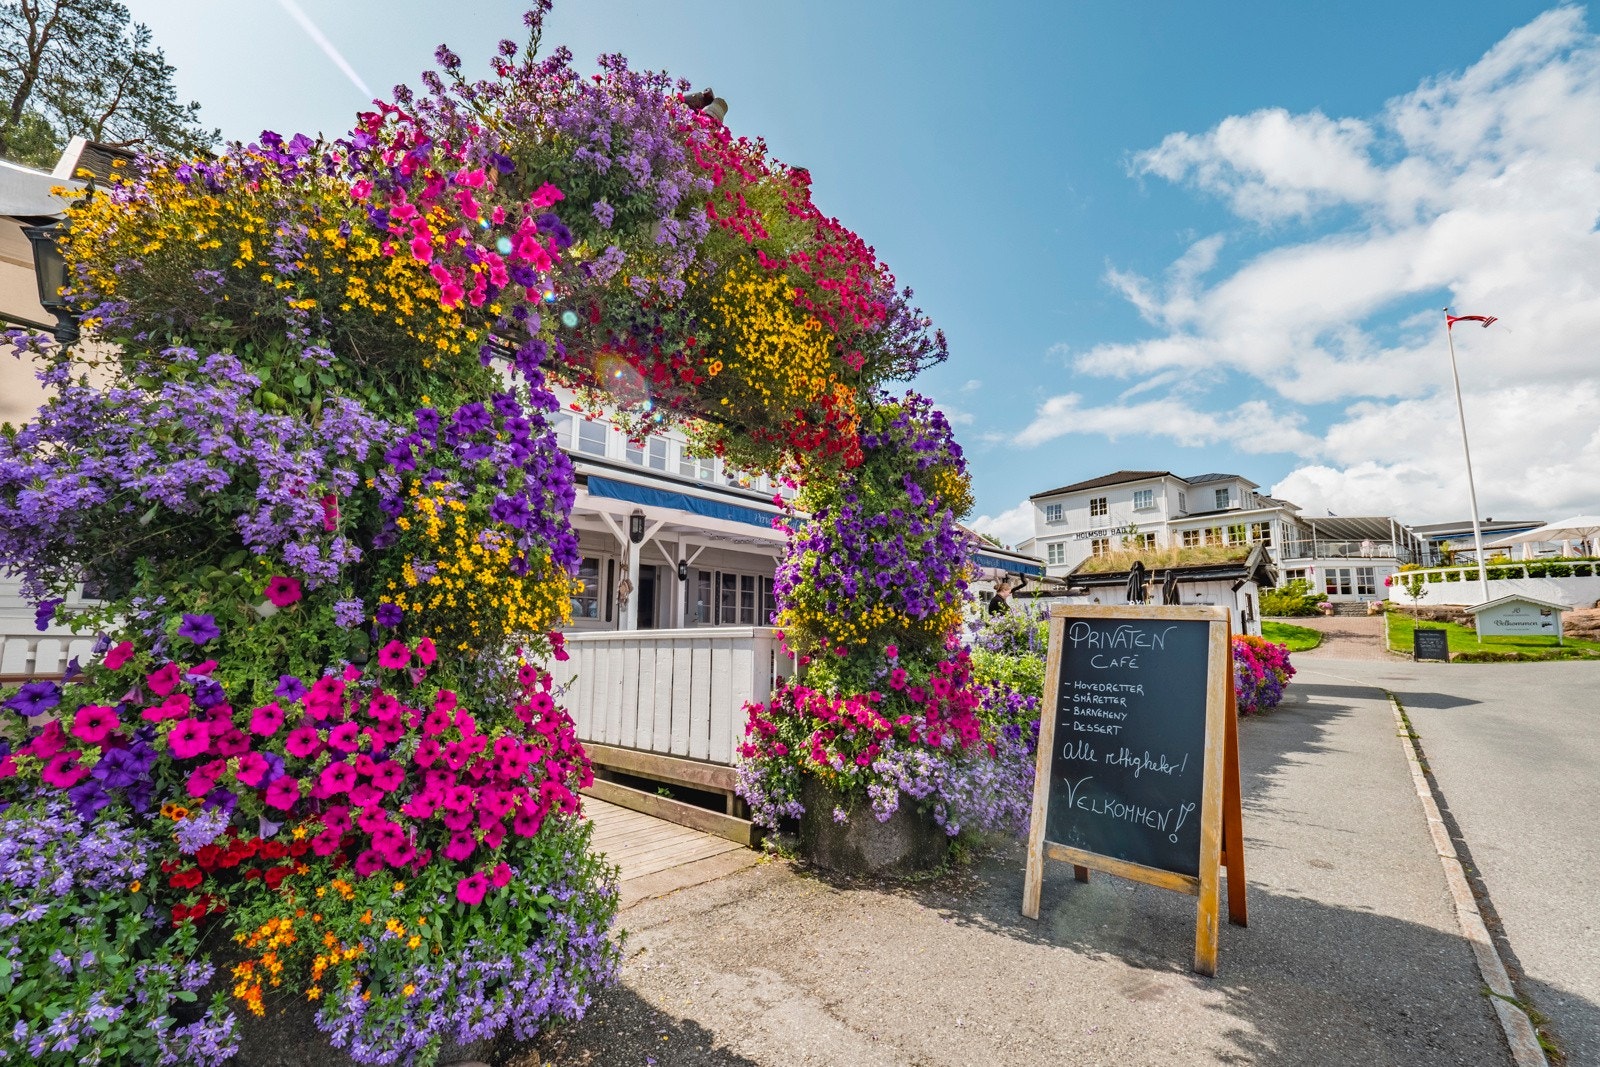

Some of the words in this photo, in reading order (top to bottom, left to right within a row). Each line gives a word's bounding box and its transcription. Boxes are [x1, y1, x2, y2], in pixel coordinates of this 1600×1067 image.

[1076, 529, 1108, 540] HOLMSBU
[1493, 619, 1538, 627] Velkommen
[1069, 621, 1178, 651] PRIVATEN
[1090, 654, 1139, 669] CAFÉ
[1074, 680, 1145, 697] HOVEDRETTER
[1072, 692, 1128, 708] SMÅRETTER
[1073, 706, 1128, 721] BARNEMENY
[1073, 721, 1123, 736] DESSERT
